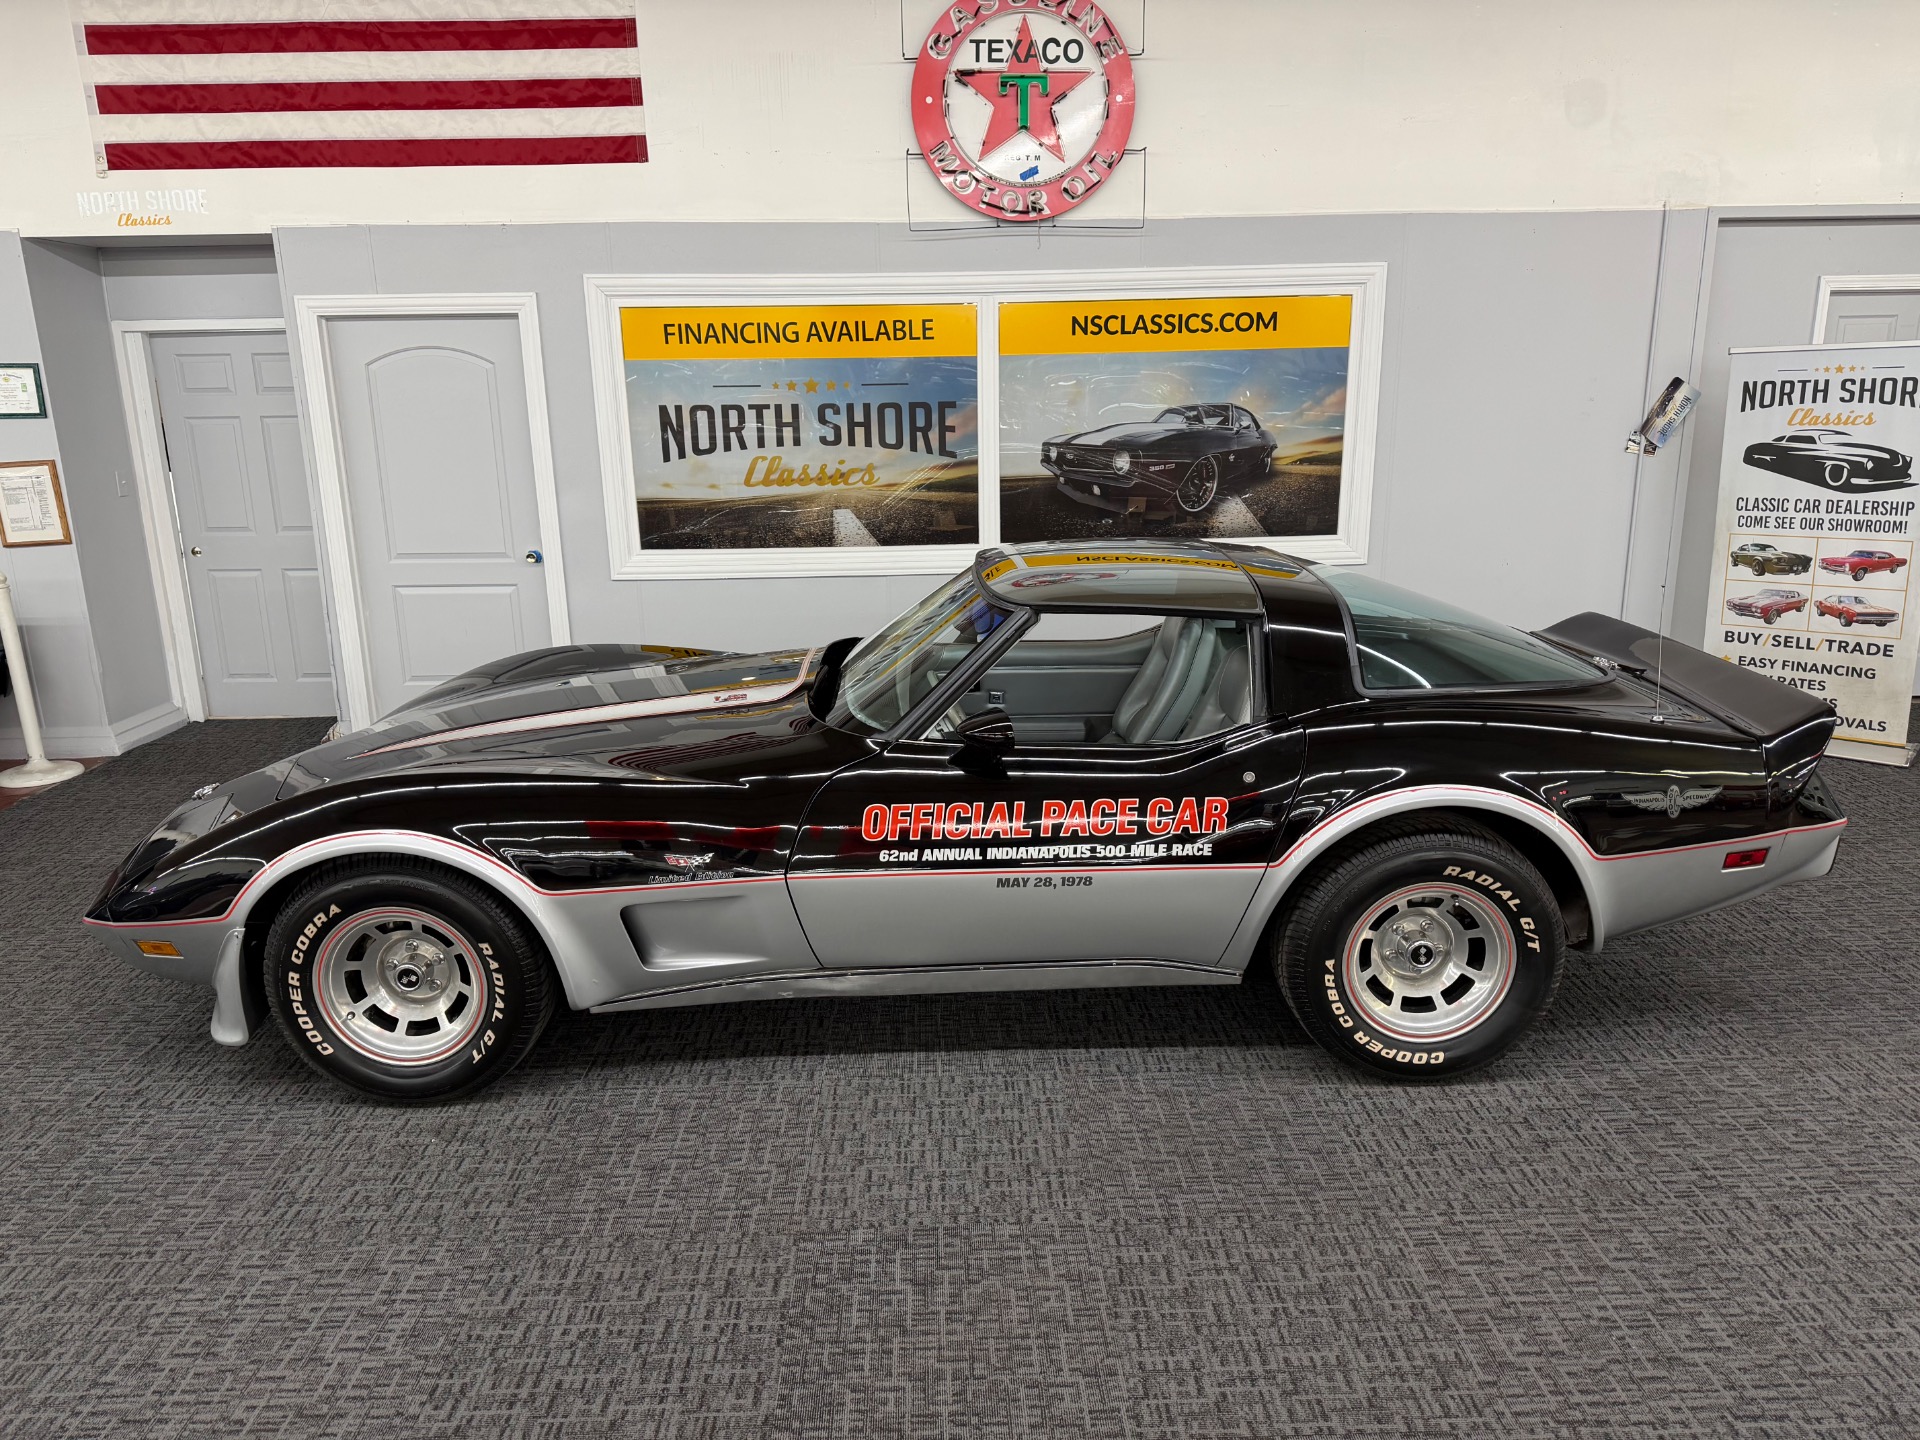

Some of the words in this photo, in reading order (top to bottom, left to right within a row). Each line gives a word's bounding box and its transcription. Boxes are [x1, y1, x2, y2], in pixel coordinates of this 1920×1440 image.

[968, 37, 1084, 65] TEXACO
[998, 73, 1049, 131] T
[929, 141, 1052, 217] MOTOR
[1061, 150, 1119, 202] OIL
[76, 190, 139, 218] NORTH
[145, 188, 210, 215] SHORE
[117, 212, 173, 227] Classics
[662, 321, 800, 345] FINANCING
[806, 318, 936, 343] AVAILABLE
[1070, 311, 1278, 337] NSCLASSICS.COM
[1740, 378, 1830, 413] NORTH
[1838, 376, 1920, 409] SHOR
[658, 402, 802, 463] NORTH
[817, 400, 958, 459] SHORE
[1787, 407, 1877, 427] Classics
[743, 455, 881, 488] Classics
[1736, 497, 1789, 513] CLASSIC
[1794, 498, 1820, 514] CAR
[1826, 500, 1915, 517] DEALERSHIP
[1737, 515, 1770, 529] COME
[1774, 516, 1796, 530] SEE
[1800, 517, 1824, 532] OUR
[1827, 518, 1908, 534] SHOWROOM!
[1723, 630, 1895, 658] BUY/SELL/TRADE
[1738, 655, 1778, 669] EASY
[1781, 660, 1877, 680] FINANCING
[1682, 793, 1711, 802] SPEEDWAY
[862, 802, 1032, 842] OFFICIAL
[1039, 799, 1140, 837] PACE
[1146, 797, 1230, 836] CAR
[878, 848, 918, 863] 62nd
[921, 847, 983, 862] ANNUAL
[986, 845, 1092, 860] INDIANAPOLIS
[1095, 845, 1126, 858] 500
[1130, 844, 1167, 858] MILE
[1171, 843, 1213, 857] RACE
[648, 872, 692, 885] Limited
[695, 870, 735, 882] Edition
[996, 877, 1031, 889] MAY
[1033, 876, 1057, 890] 28,
[1060, 876, 1093, 888] 1978
[1442, 865, 1522, 912] RADIAL
[1518, 916, 1541, 953] G/T
[290, 903, 343, 966] COBRA
[477, 941, 506, 1023] RADIAL
[1323, 958, 1355, 1029] COBRA
[287, 970, 335, 1057] COOPER
[471, 1028, 497, 1065] G/T
[1352, 1030, 1446, 1066] COOPER
